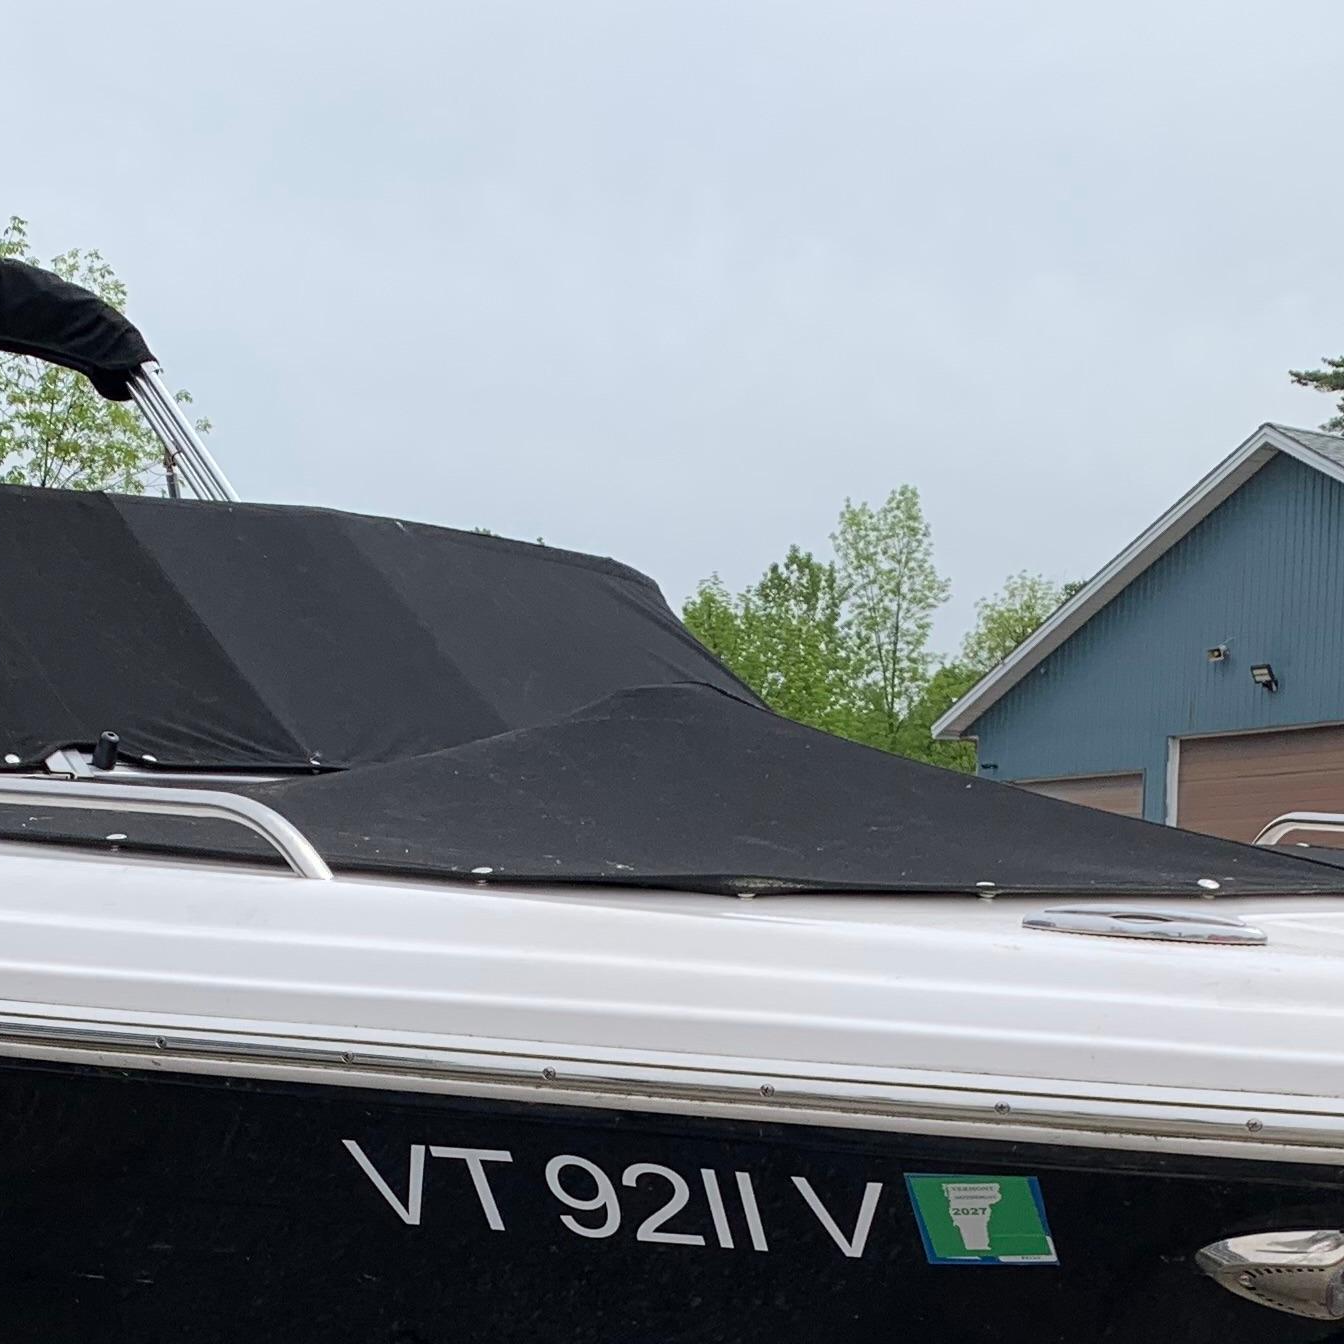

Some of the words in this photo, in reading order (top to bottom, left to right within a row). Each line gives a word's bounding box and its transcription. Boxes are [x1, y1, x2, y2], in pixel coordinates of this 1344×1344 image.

[342, 1139, 513, 1231] VT
[545, 1154, 769, 1252] 9211
[790, 1176, 883, 1258] V
[953, 1207, 988, 1216] 2027
